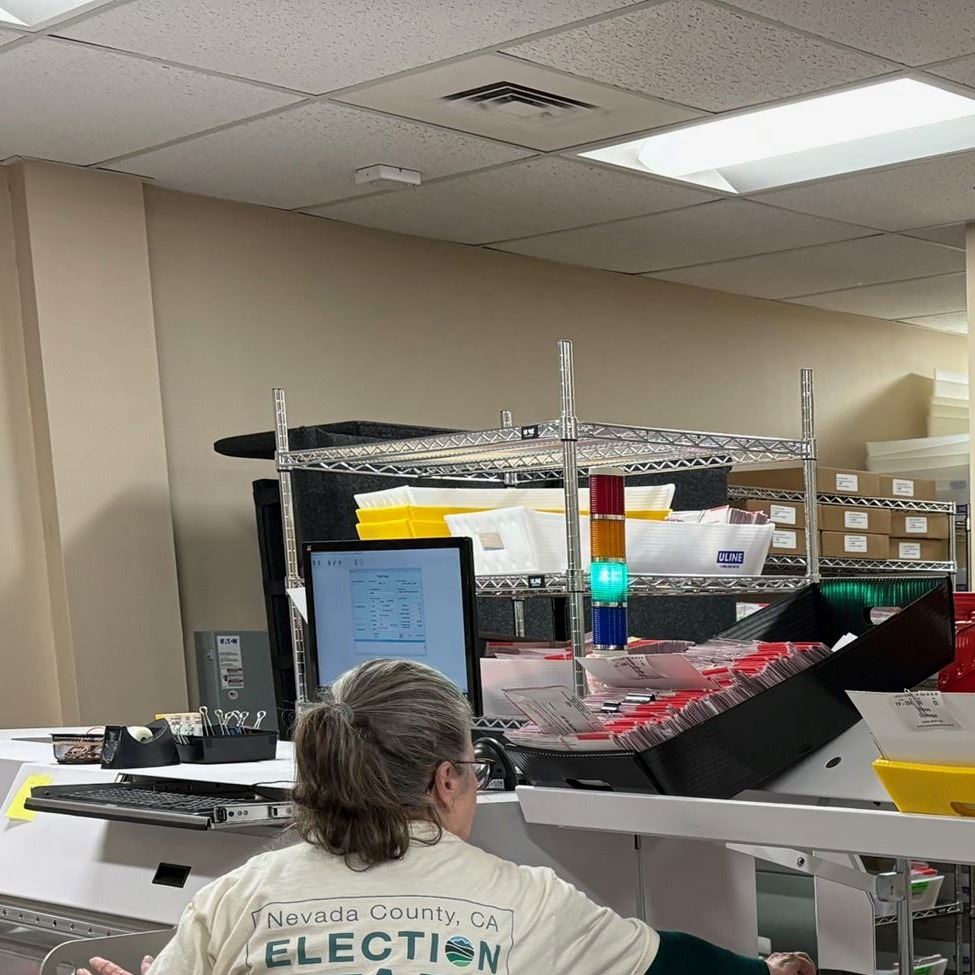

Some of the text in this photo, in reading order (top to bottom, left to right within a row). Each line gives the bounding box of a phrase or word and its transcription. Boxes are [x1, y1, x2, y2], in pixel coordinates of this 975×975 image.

[718, 552, 744, 562] ULINE
[267, 904, 500, 933] Nevada County, CA
[265, 930, 501, 975] ELECTION
